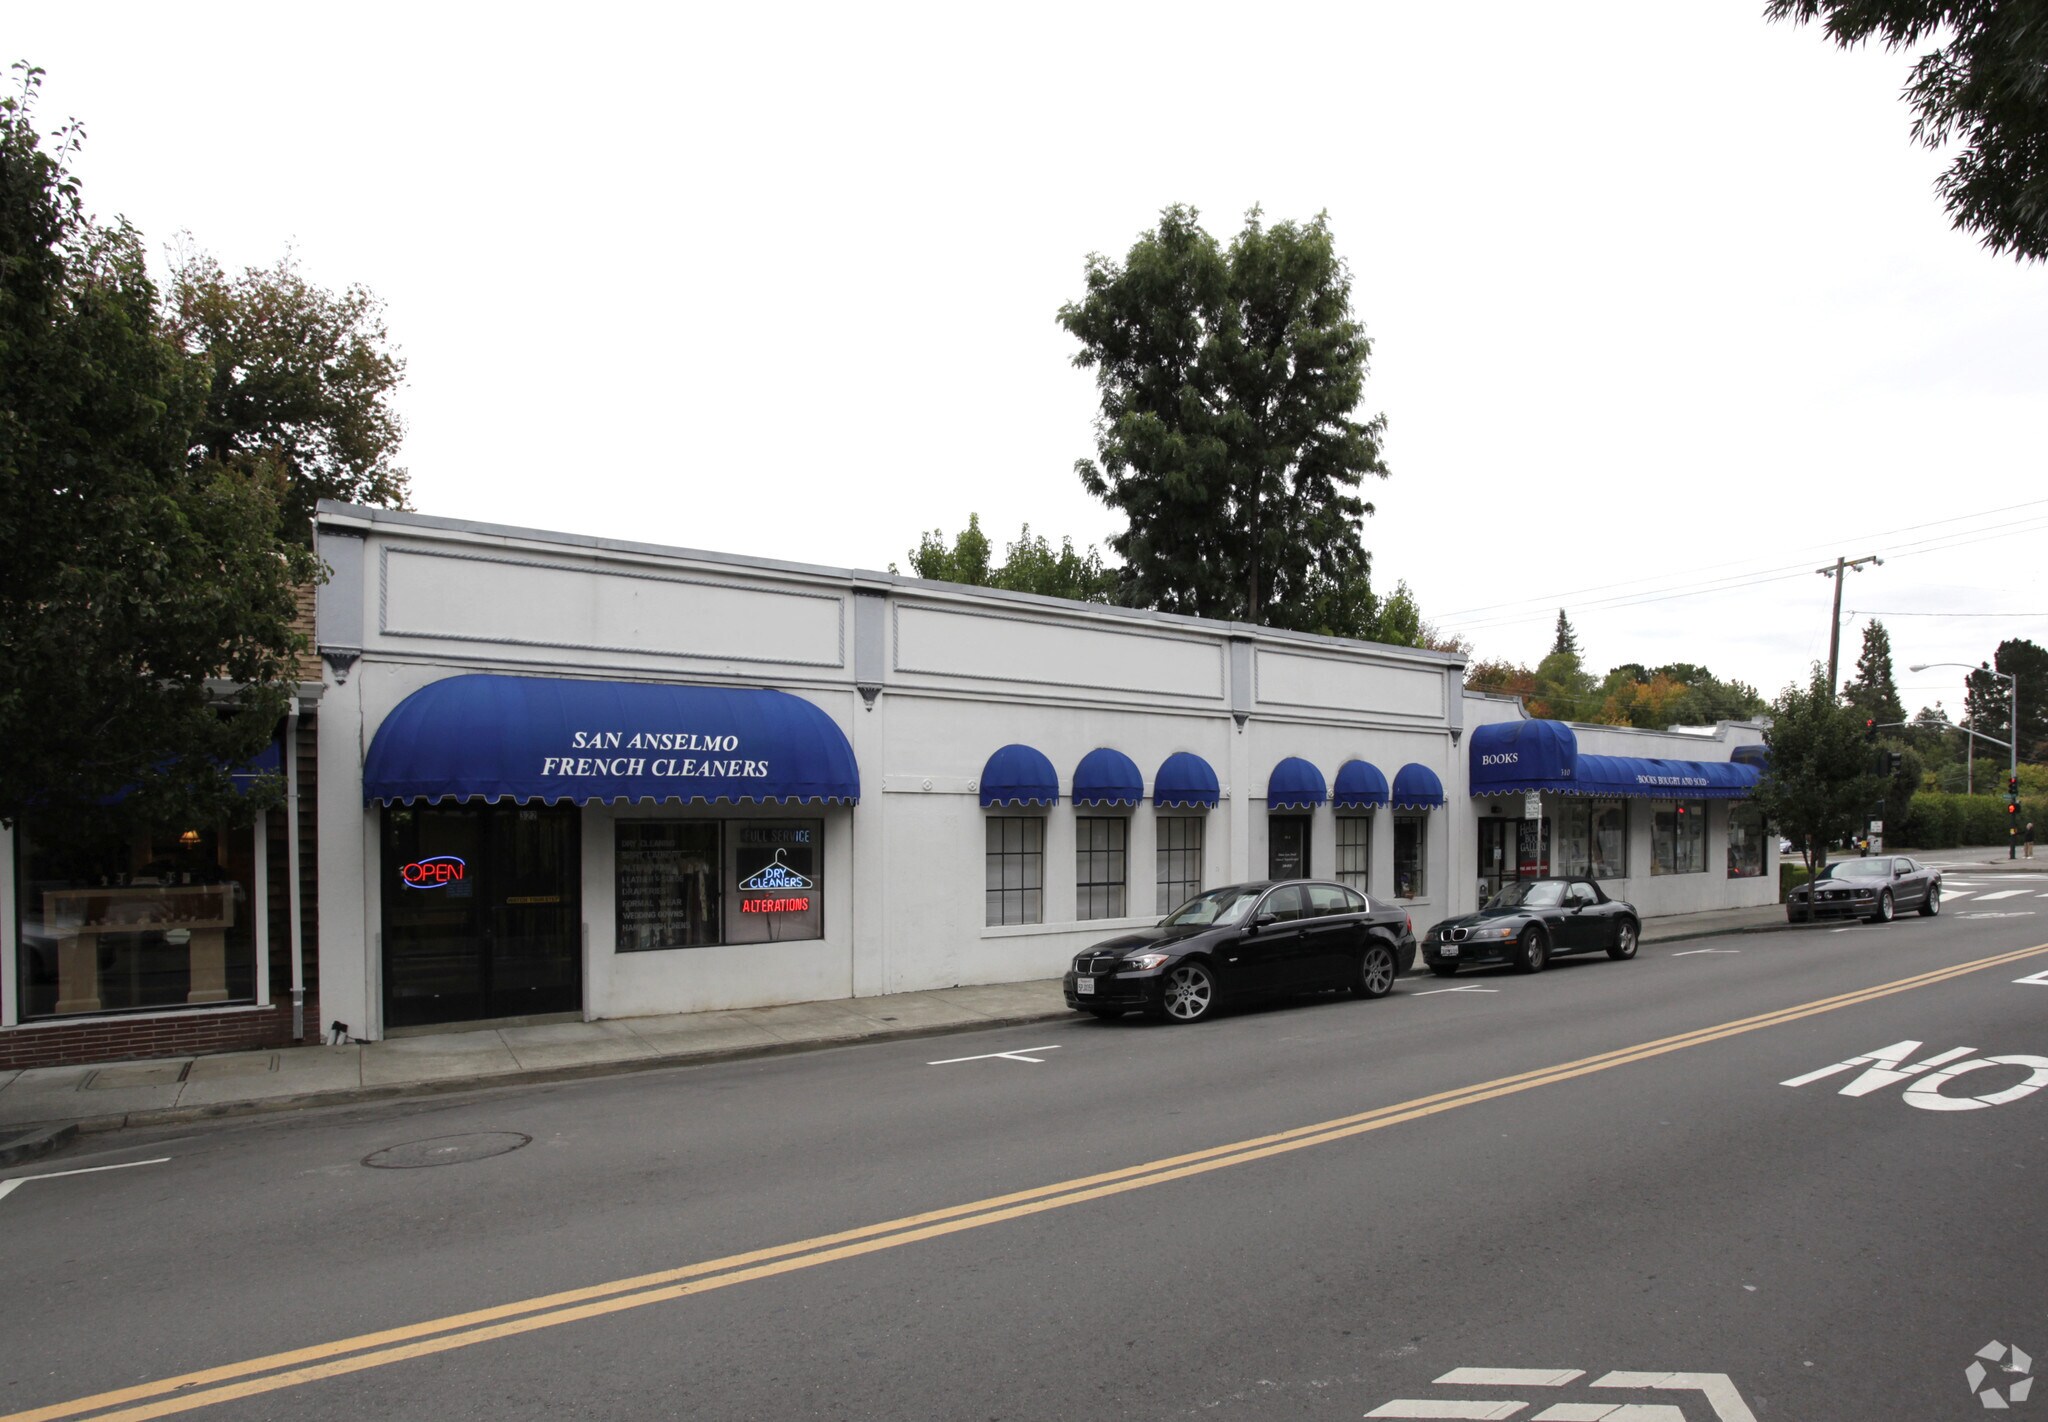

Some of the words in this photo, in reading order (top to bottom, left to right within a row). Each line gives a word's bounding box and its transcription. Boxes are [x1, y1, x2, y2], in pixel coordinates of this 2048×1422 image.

[572, 731, 622, 749] SAN
[627, 732, 739, 752] ANSELMO
[1482, 752, 1519, 766] BOOKS
[541, 757, 644, 777] FRENCH
[651, 759, 769, 778] CLEANERS
[1658, 776, 1680, 785] BOUGHT
[1681, 777, 1693, 785] AND
[745, 830, 767, 842] FULL
[771, 830, 810, 842] SERVICE
[1525, 834, 1540, 843] BOO
[1520, 842, 1547, 851] GALLRY
[403, 863, 464, 882] OPEN
[765, 868, 787, 879] DRY
[750, 877, 803, 888] CLEANERS
[743, 897, 809, 913] ALTERATIONS
[623, 911, 656, 920] WEDDING
[1779, 1040, 2048, 1111] NO
